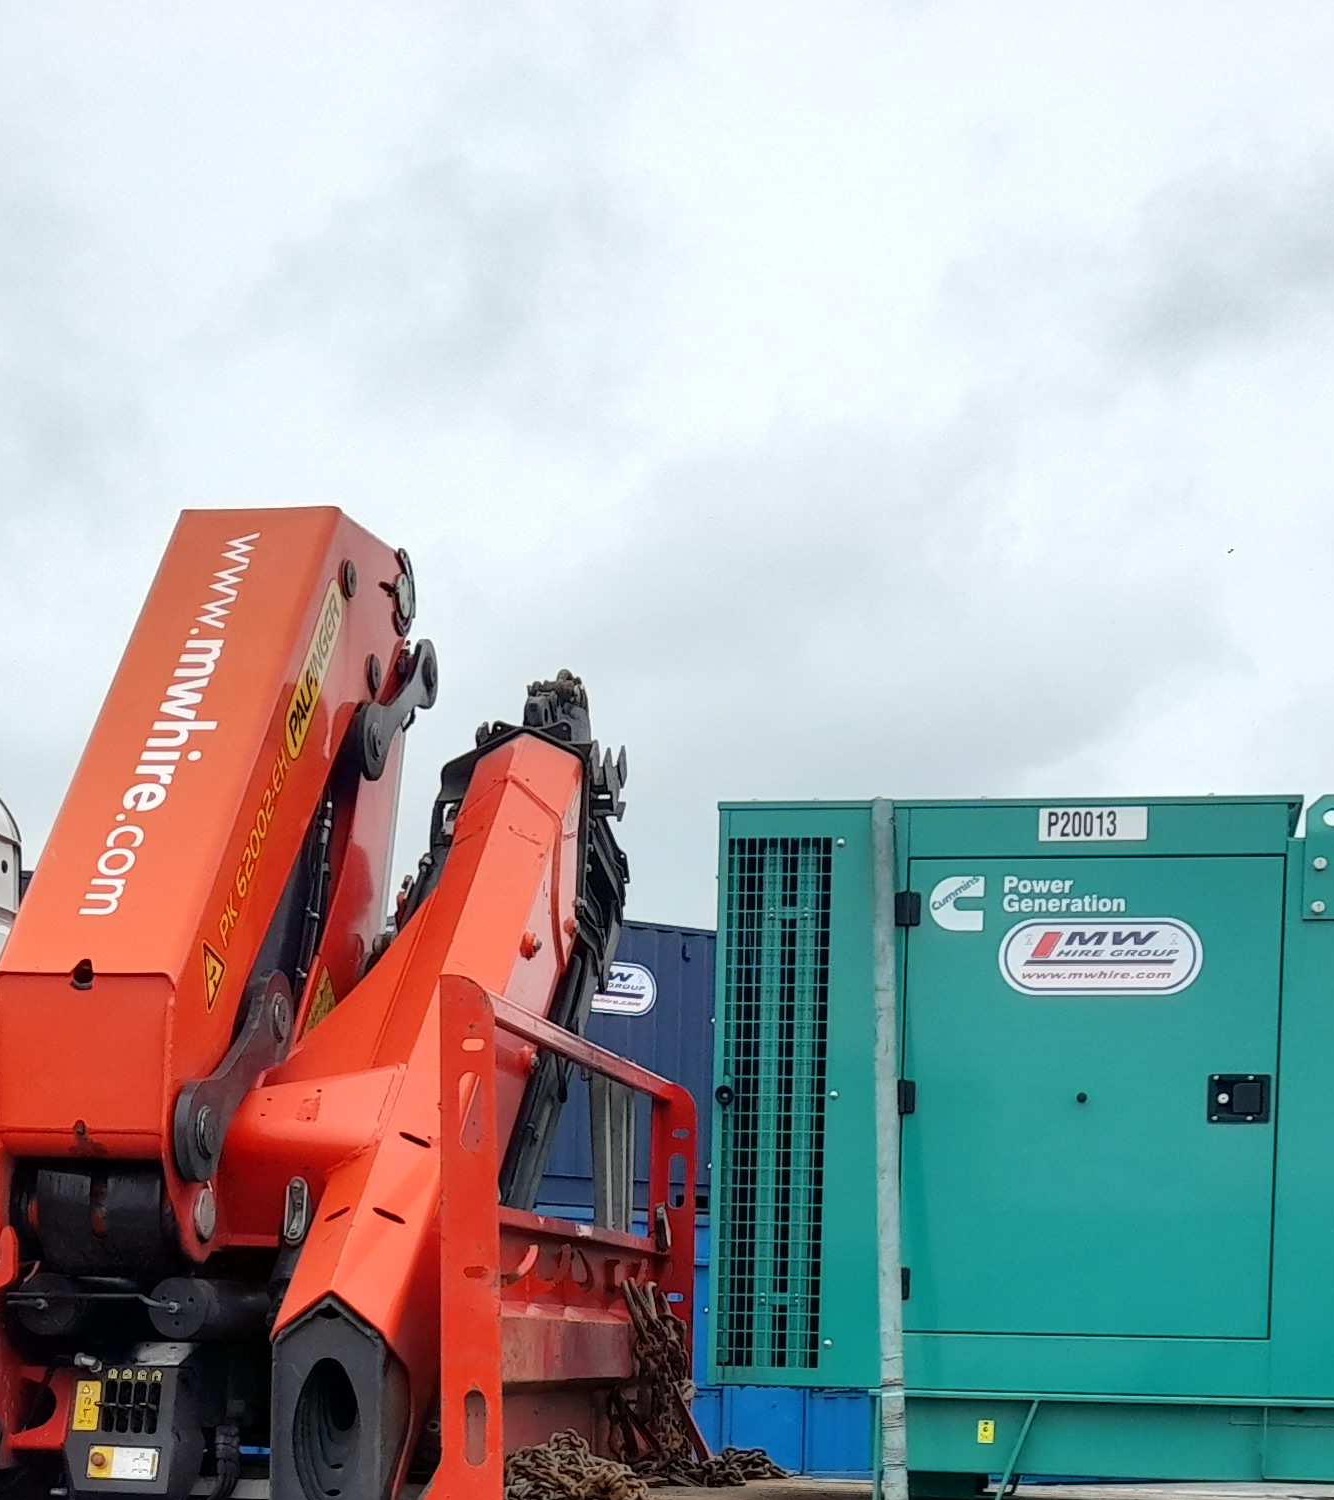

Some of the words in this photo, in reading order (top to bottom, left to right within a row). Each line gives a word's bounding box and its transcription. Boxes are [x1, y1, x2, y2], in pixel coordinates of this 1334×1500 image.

[287, 592, 341, 748] PALFINGER
[78, 531, 261, 916] www.mwhire.com
[1046, 810, 1118, 838] P20013
[218, 891, 239, 948] PK
[235, 746, 289, 900] 62002-EH
[931, 876, 981, 911] Cummins
[1002, 875, 1074, 894] Power
[1002, 894, 1126, 913] Generation
[1064, 930, 1160, 946] MW
[1056, 949, 1104, 958] HIRE
[1109, 949, 1180, 958] GROUP
[608, 971, 635, 982] W
[1021, 969, 1172, 981] www.mwhire.com
